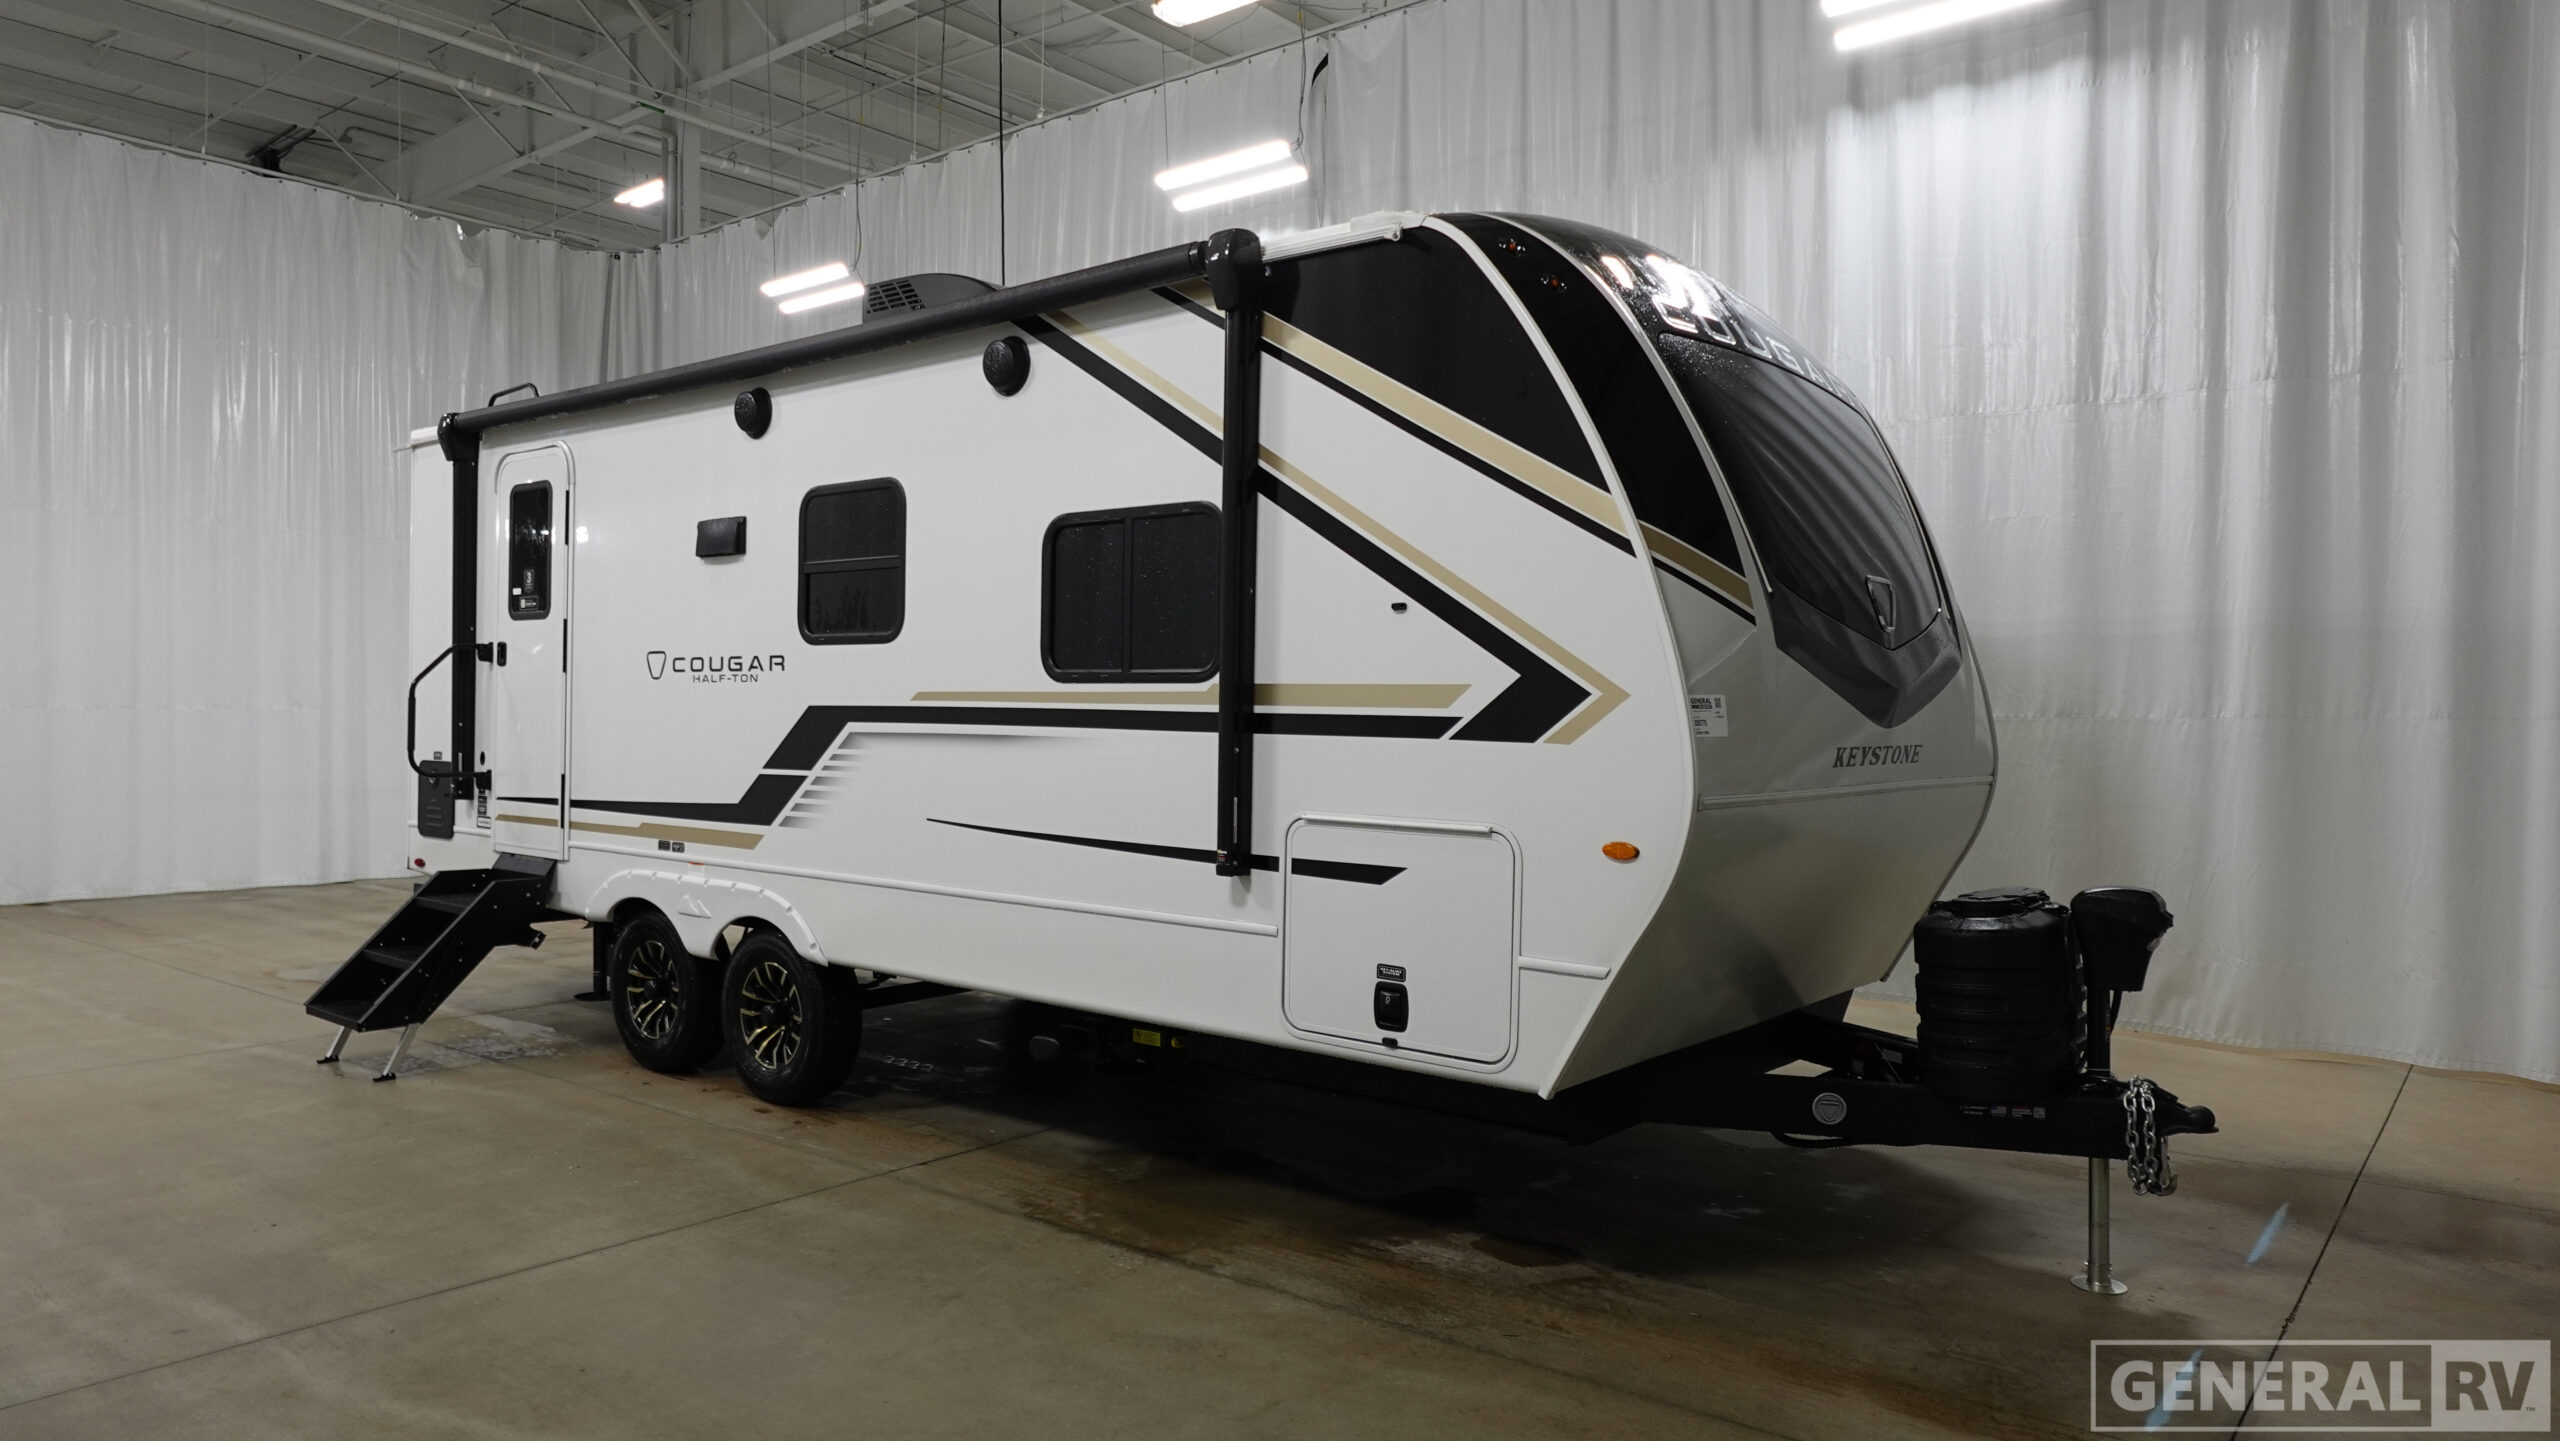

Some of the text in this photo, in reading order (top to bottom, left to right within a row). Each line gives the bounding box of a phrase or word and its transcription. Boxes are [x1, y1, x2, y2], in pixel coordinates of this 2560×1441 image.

[672, 655, 786, 672] COUGAR
[693, 674, 759, 683] HALF-TON
[1832, 744, 1923, 769] KEYSTONE
